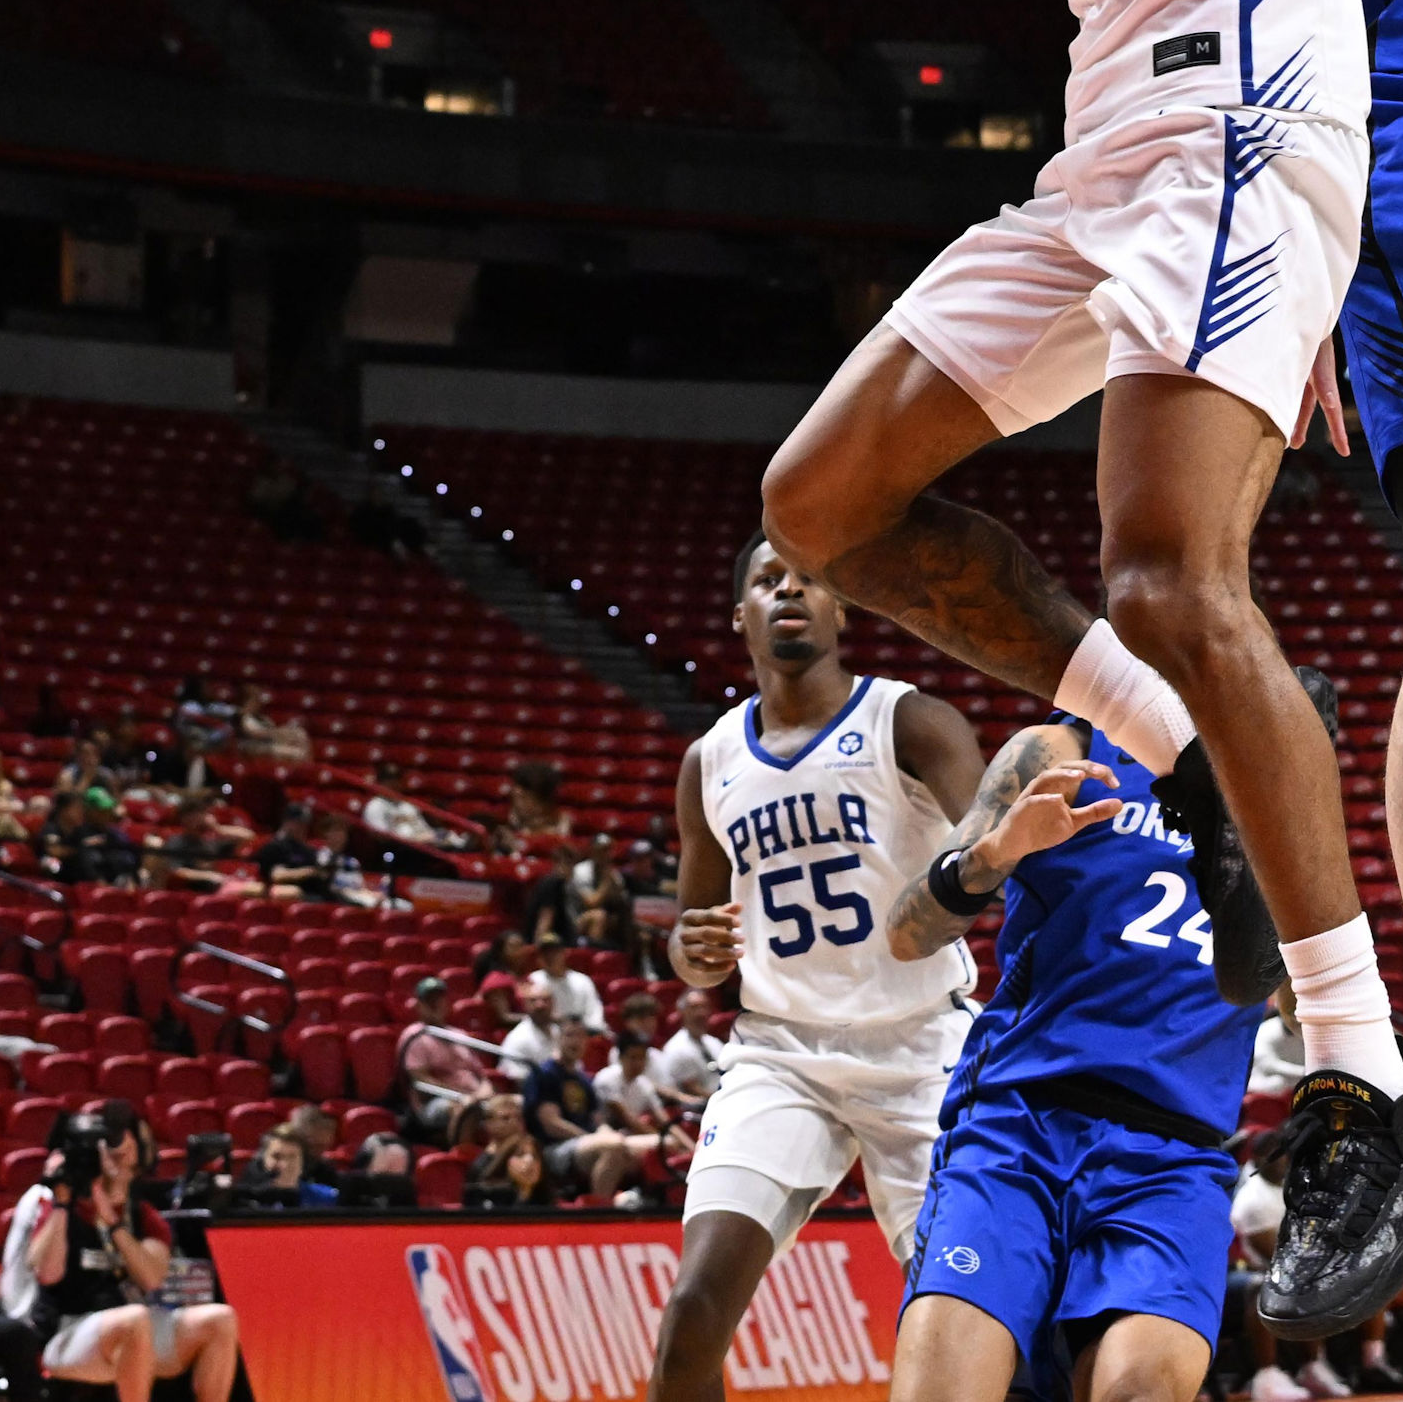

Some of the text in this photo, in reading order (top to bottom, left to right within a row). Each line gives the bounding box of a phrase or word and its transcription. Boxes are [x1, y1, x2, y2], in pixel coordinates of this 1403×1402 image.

[1196, 41, 1210, 55] M
[727, 793, 876, 876] PHILA
[758, 853, 874, 959] 55
[1308, 1078, 1336, 1094] FROM
